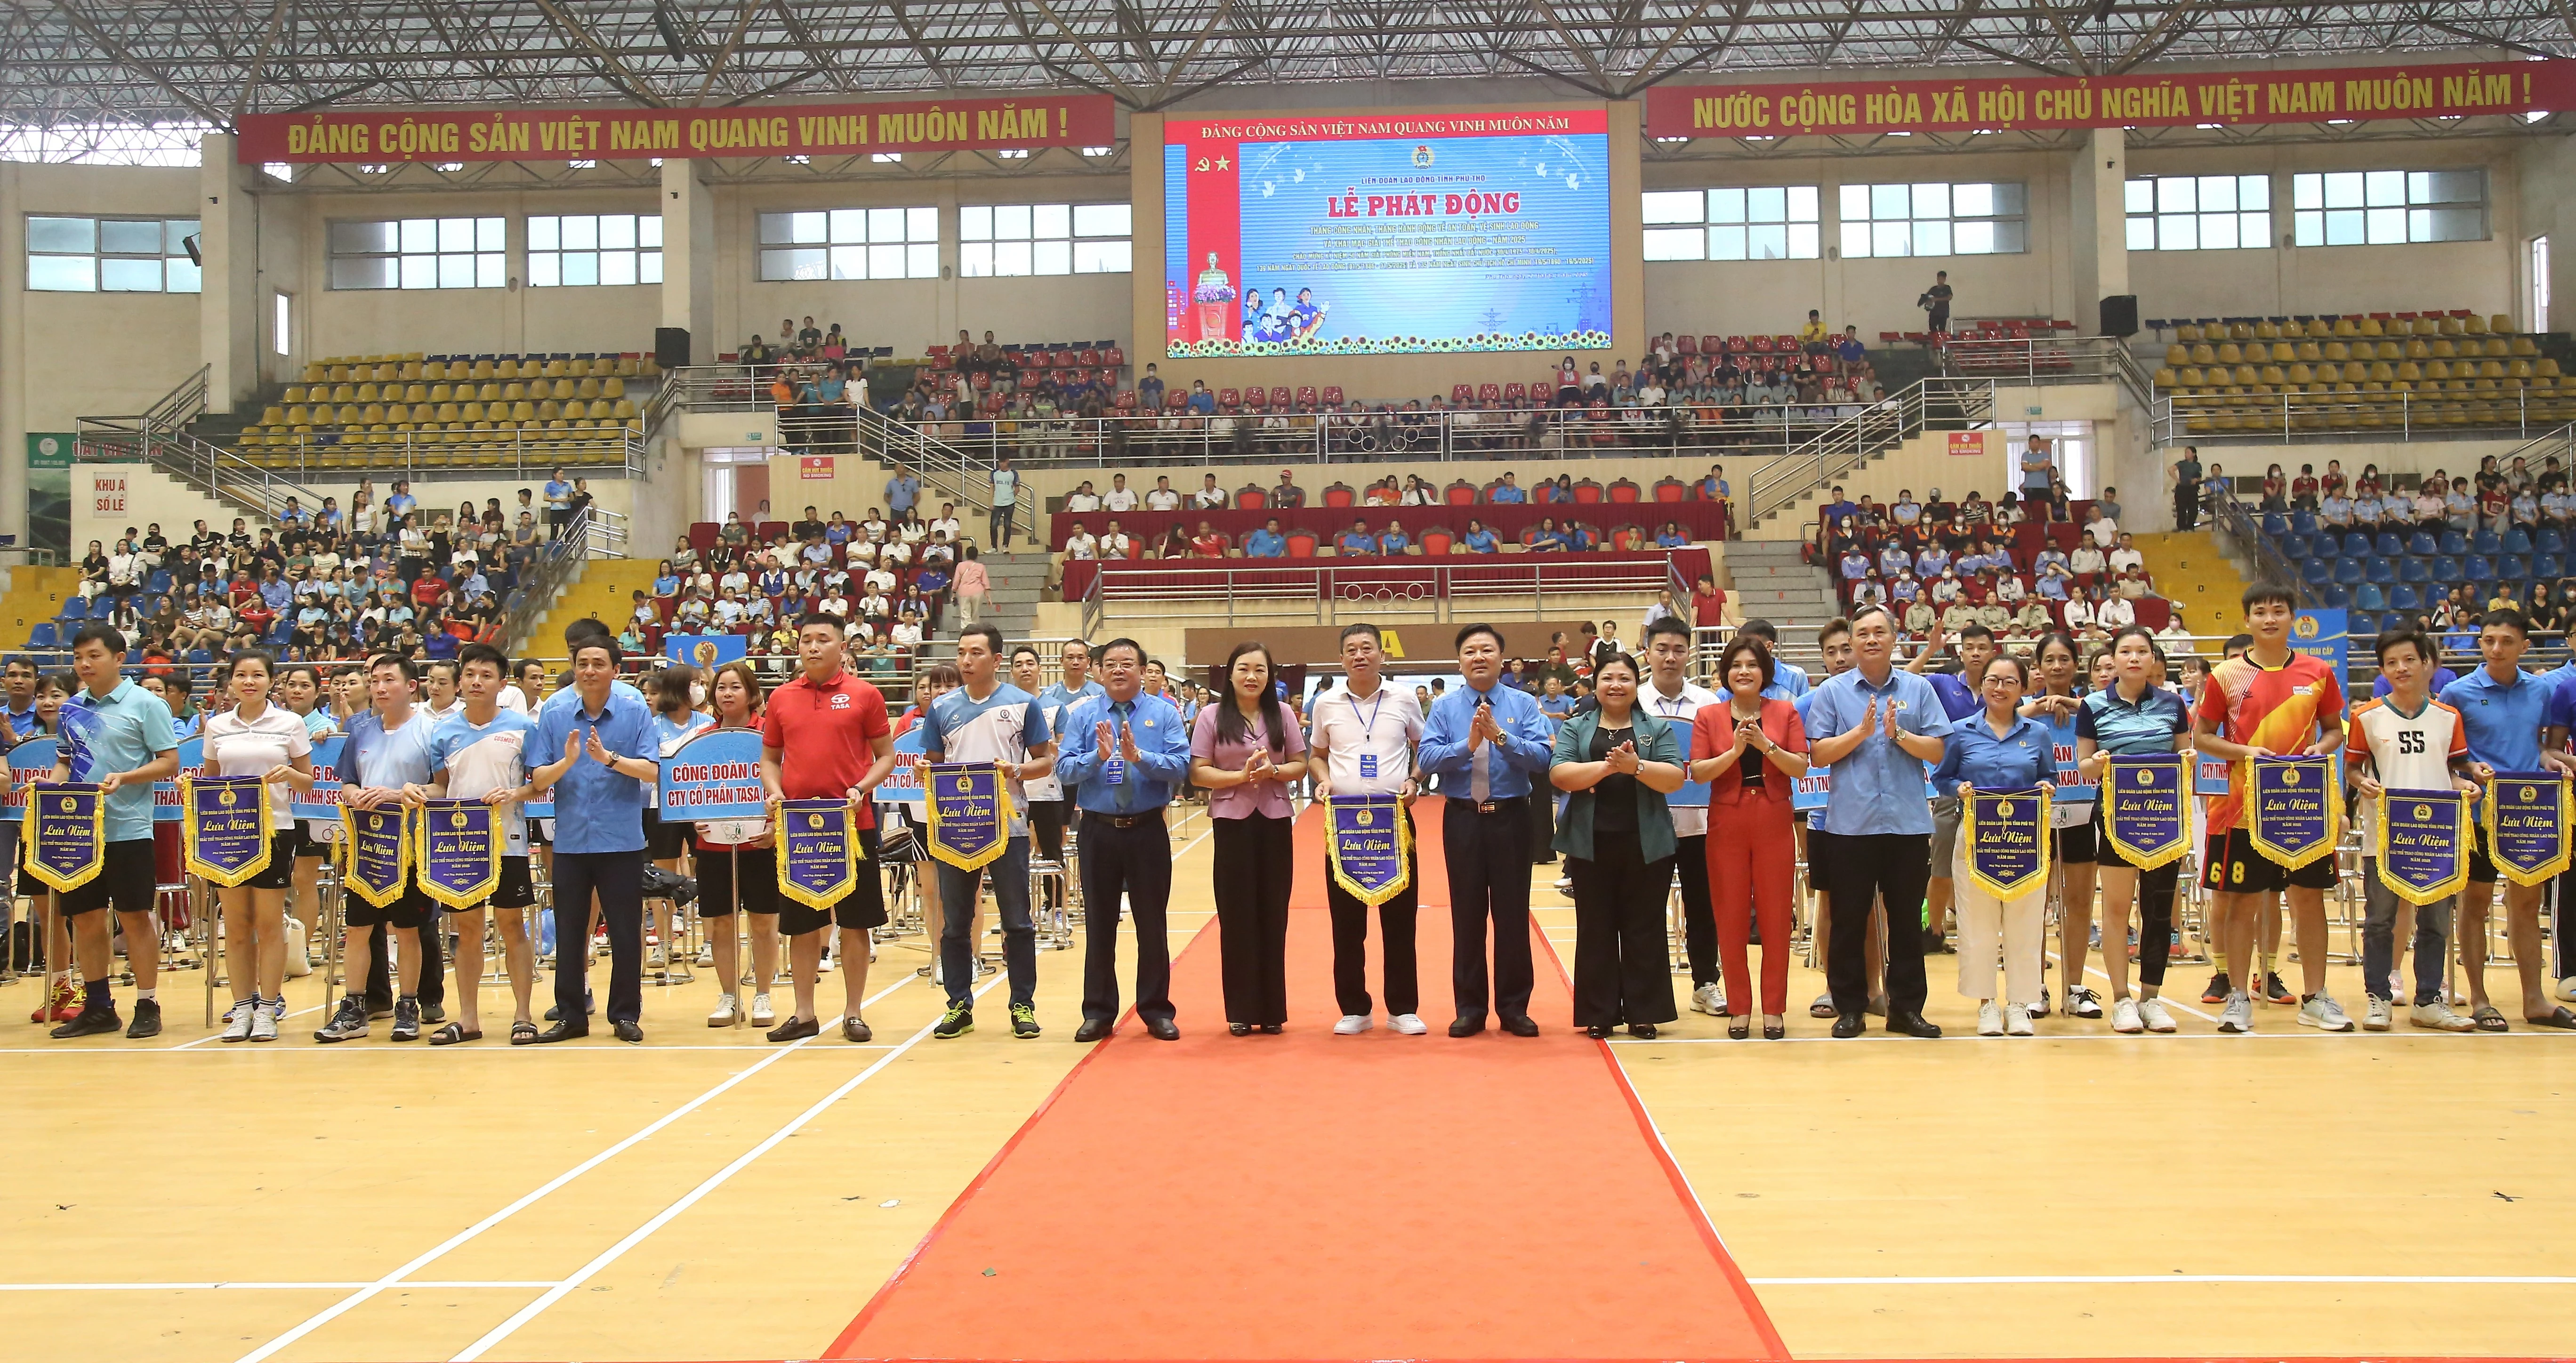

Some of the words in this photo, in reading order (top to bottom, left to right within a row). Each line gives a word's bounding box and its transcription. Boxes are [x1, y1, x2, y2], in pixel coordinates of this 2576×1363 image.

[1694, 90, 1770, 128] NƯỚC
[1780, 89, 1856, 133] CỘNG
[1866, 86, 1923, 123] HÒA
[1932, 86, 1970, 122] XÃ
[1979, 84, 2025, 128] HỘI
[2035, 79, 2092, 120] CHỦ
[2102, 81, 2190, 118] NGHĨA
[2199, 78, 2259, 122] VIỆT
[2269, 82, 2335, 113] NAM
[2346, 72, 2433, 111] MUÔN
[2444, 69, 2511, 106] NĂM
[2524, 73, 2530, 103] !
[288, 114, 369, 154] ĐẢNG
[380, 117, 459, 160] CỘNG
[470, 113, 530, 152] SẢN
[539, 116, 601, 157] VIỆT
[611, 121, 679, 149] NAM
[690, 118, 788, 152] QUANG
[799, 116, 867, 145] VINH
[878, 106, 968, 143] MUÔN
[979, 103, 1047, 139] NĂM
[1060, 108, 1067, 137] !
[1201, 123, 1242, 138] ĐẢNG
[1246, 122, 1287, 140] CỘNG
[1290, 121, 1318, 136] SẢN
[1321, 121, 1355, 138] VIỆT
[1358, 122, 1391, 135] NAM
[1394, 121, 1446, 136] QUANG
[1449, 120, 1486, 132] VINH
[1489, 116, 1532, 131] MUÔN
[1536, 115, 1569, 130] NĂM
[1329, 187, 1358, 217] LỄ
[1368, 190, 1436, 217] PHÁT
[1446, 189, 1519, 218] ĐỘNG
[1310, 225, 1332, 234] THÁNG
[1333, 224, 1351, 234] CÔNG
[1375, 223, 1396, 234] THÁNG
[1399, 223, 1416, 233] HÀNH
[1417, 222, 1436, 234] ĐỘNG
[1437, 221, 1446, 232] VỀ
[1447, 224, 1457, 232] AN
[1480, 221, 1487, 232] VỆ
[1489, 222, 1505, 230] SINH
[1506, 222, 1519, 230] LAO
[1521, 220, 1539, 231] ĐỘNG
[1323, 238, 1332, 248] VÀ
[1333, 240, 1350, 248] KHAI
[1351, 239, 1366, 249] MẠC
[1368, 236, 1381, 247] GIẢI
[1383, 235, 1394, 247] THỂ
[1396, 238, 1412, 246] THAO
[1414, 236, 1432, 246] CÔNG
[1434, 236, 1452, 245] NHÂN
[1454, 237, 1466, 245] LAO
[1468, 235, 1486, 246] ĐỘNG
[1492, 234, 1507, 244] NĂM
[1509, 235, 1526, 243] 2025
[96, 479, 115, 491] KHU
[118, 479, 125, 491] A
[97, 494, 110, 511] SỐ
[113, 494, 124, 511] LẺ
[1380, 630, 1405, 658] A
[494, 735, 515, 744] COSMOS
[673, 763, 708, 782] CÔNG
[711, 761, 748, 780] ĐOÀN
[900, 769, 911, 788] CỔ
[2201, 763, 2214, 779] CTY
[1797, 777, 1814, 793] CTY
[668, 790, 686, 807] CTY
[689, 784, 703, 805] CỔ
[705, 783, 733, 804] PHẦN
[736, 786, 761, 802] TASA
[941, 807, 960, 817] Lưu
[964, 805, 990, 819] Niệm
[2119, 799, 2141, 811] Lưu
[2144, 799, 2173, 814] Niệm
[2265, 799, 2286, 810] Lưu
[2289, 798, 2318, 813] Niệm
[203, 820, 224, 831] Lưu
[227, 820, 255, 832] Niệm
[2501, 815, 2520, 827] Lưu
[2523, 815, 2553, 831] Niệm
[44, 824, 64, 836] Lưu
[67, 825, 90, 839] Niệm
[1980, 831, 2002, 843] Lưu
[2005, 831, 2032, 846] Niệm
[361, 840, 373, 852] Lưu
[374, 843, 394, 858] Niệm
[435, 841, 456, 853] Lưu
[459, 840, 485, 855] Niệm
[793, 842, 813, 854] Lưu
[816, 842, 842, 855] Niệm
[1342, 839, 1362, 850] Lưu
[1364, 839, 1391, 854] Niệm
[2393, 833, 2415, 845] Lưu
[2419, 834, 2449, 849] Niệm
[2209, 862, 2222, 883] 6
[2232, 861, 2245, 884] 8
